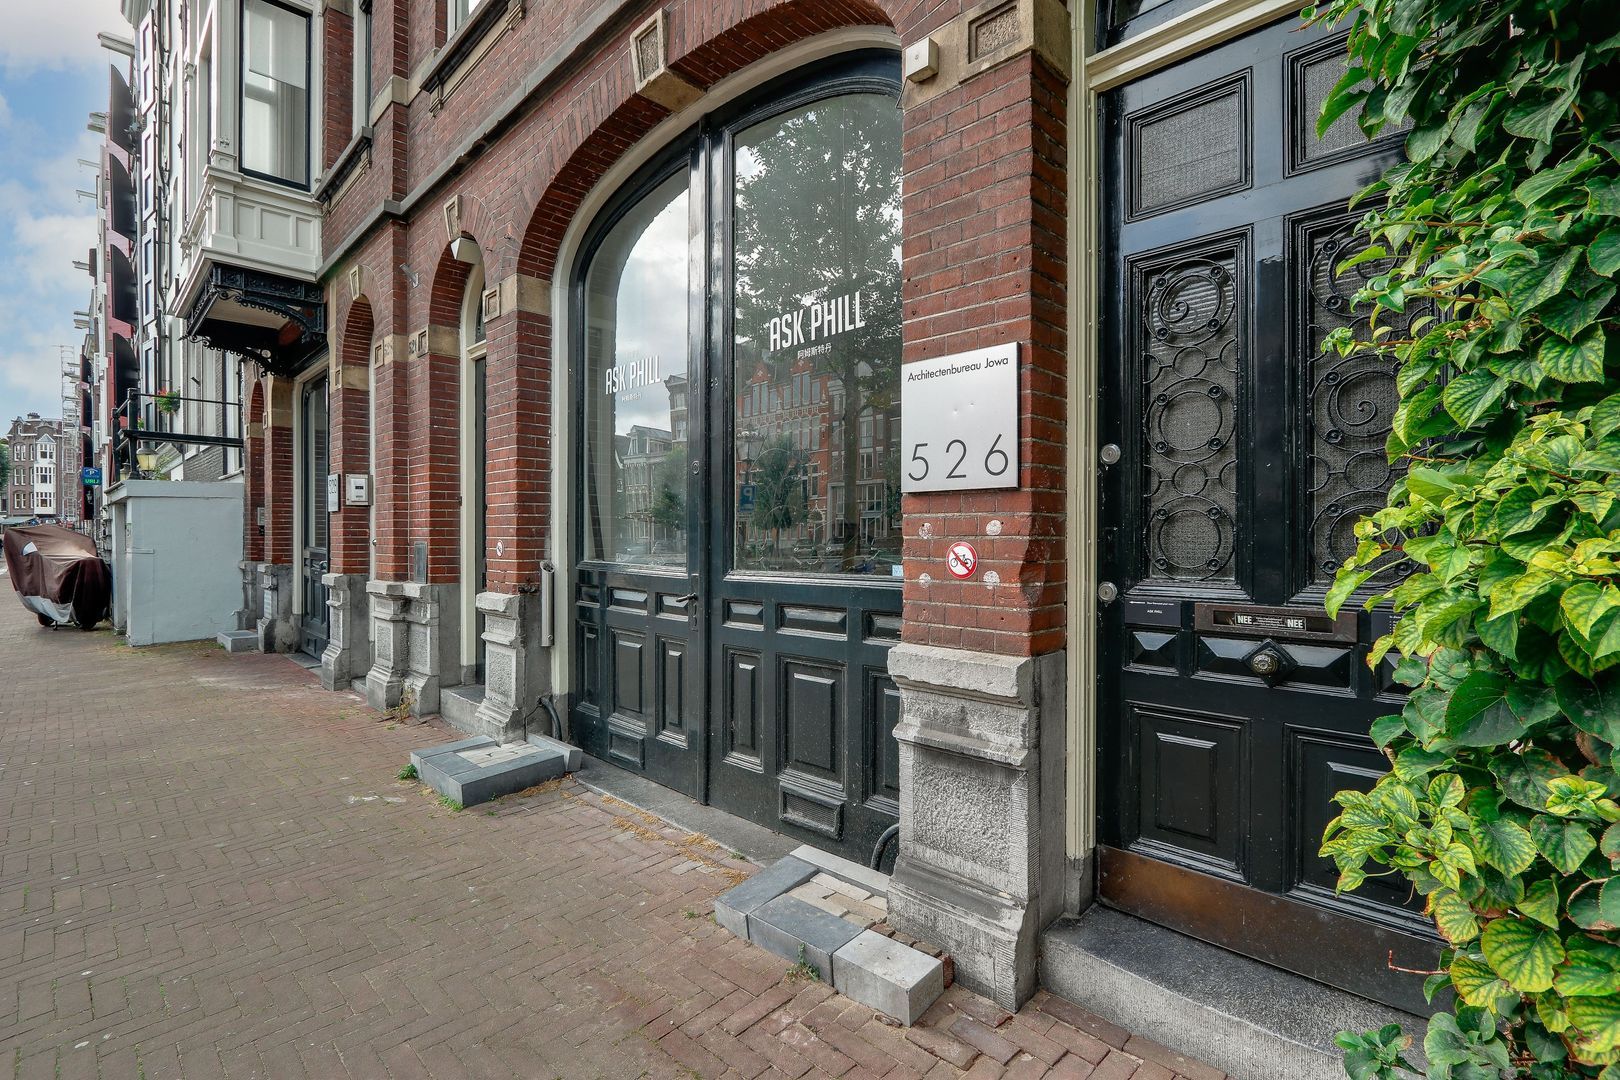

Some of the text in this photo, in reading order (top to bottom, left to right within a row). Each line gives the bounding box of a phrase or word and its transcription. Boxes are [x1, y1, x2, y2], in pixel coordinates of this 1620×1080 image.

[769, 290, 866, 352] ASK PHILL
[605, 355, 661, 395] ASK PHILL
[907, 357, 1009, 382] Architectenbureau Jowa
[1237, 615, 1253, 625] NEE
[1287, 618, 1304, 629] NEE
